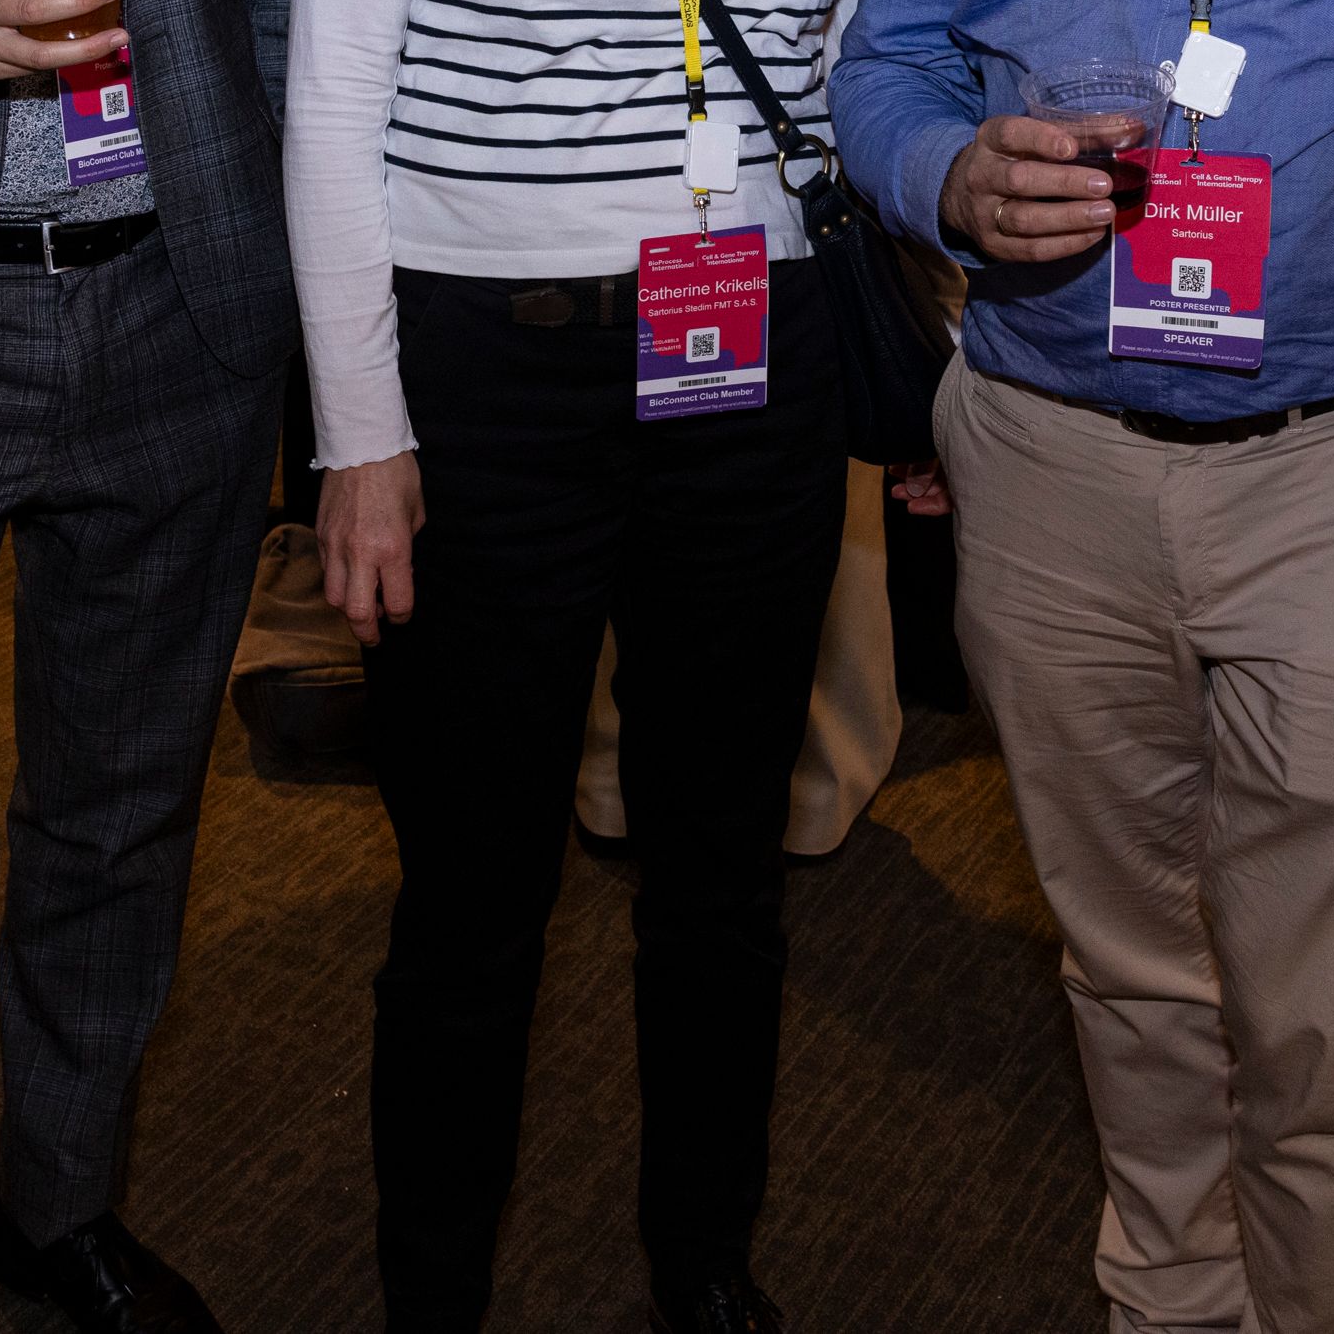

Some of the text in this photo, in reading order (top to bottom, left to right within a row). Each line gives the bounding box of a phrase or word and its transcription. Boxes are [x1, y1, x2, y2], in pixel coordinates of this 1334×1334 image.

[77, 153, 118, 169] BioConnect
[119, 149, 135, 160] Club
[1197, 180, 1244, 189] International
[1213, 174, 1232, 182] Gene
[1233, 175, 1263, 185] Therapy
[1144, 202, 1244, 223] Dirk Müller
[1171, 228, 1214, 240] Sartorius
[648, 258, 683, 267] BioProcess
[652, 261, 695, 272] International
[707, 257, 745, 266] International
[638, 276, 768, 302] Catherine Krikelis
[648, 298, 758, 317] Sartorius Stedim FMT S.A.S.
[1149, 299, 1231, 313] POSTER PRESENTER
[1163, 333, 1213, 347] SPEAKER
[649, 388, 754, 407] BioConnect Club Member
